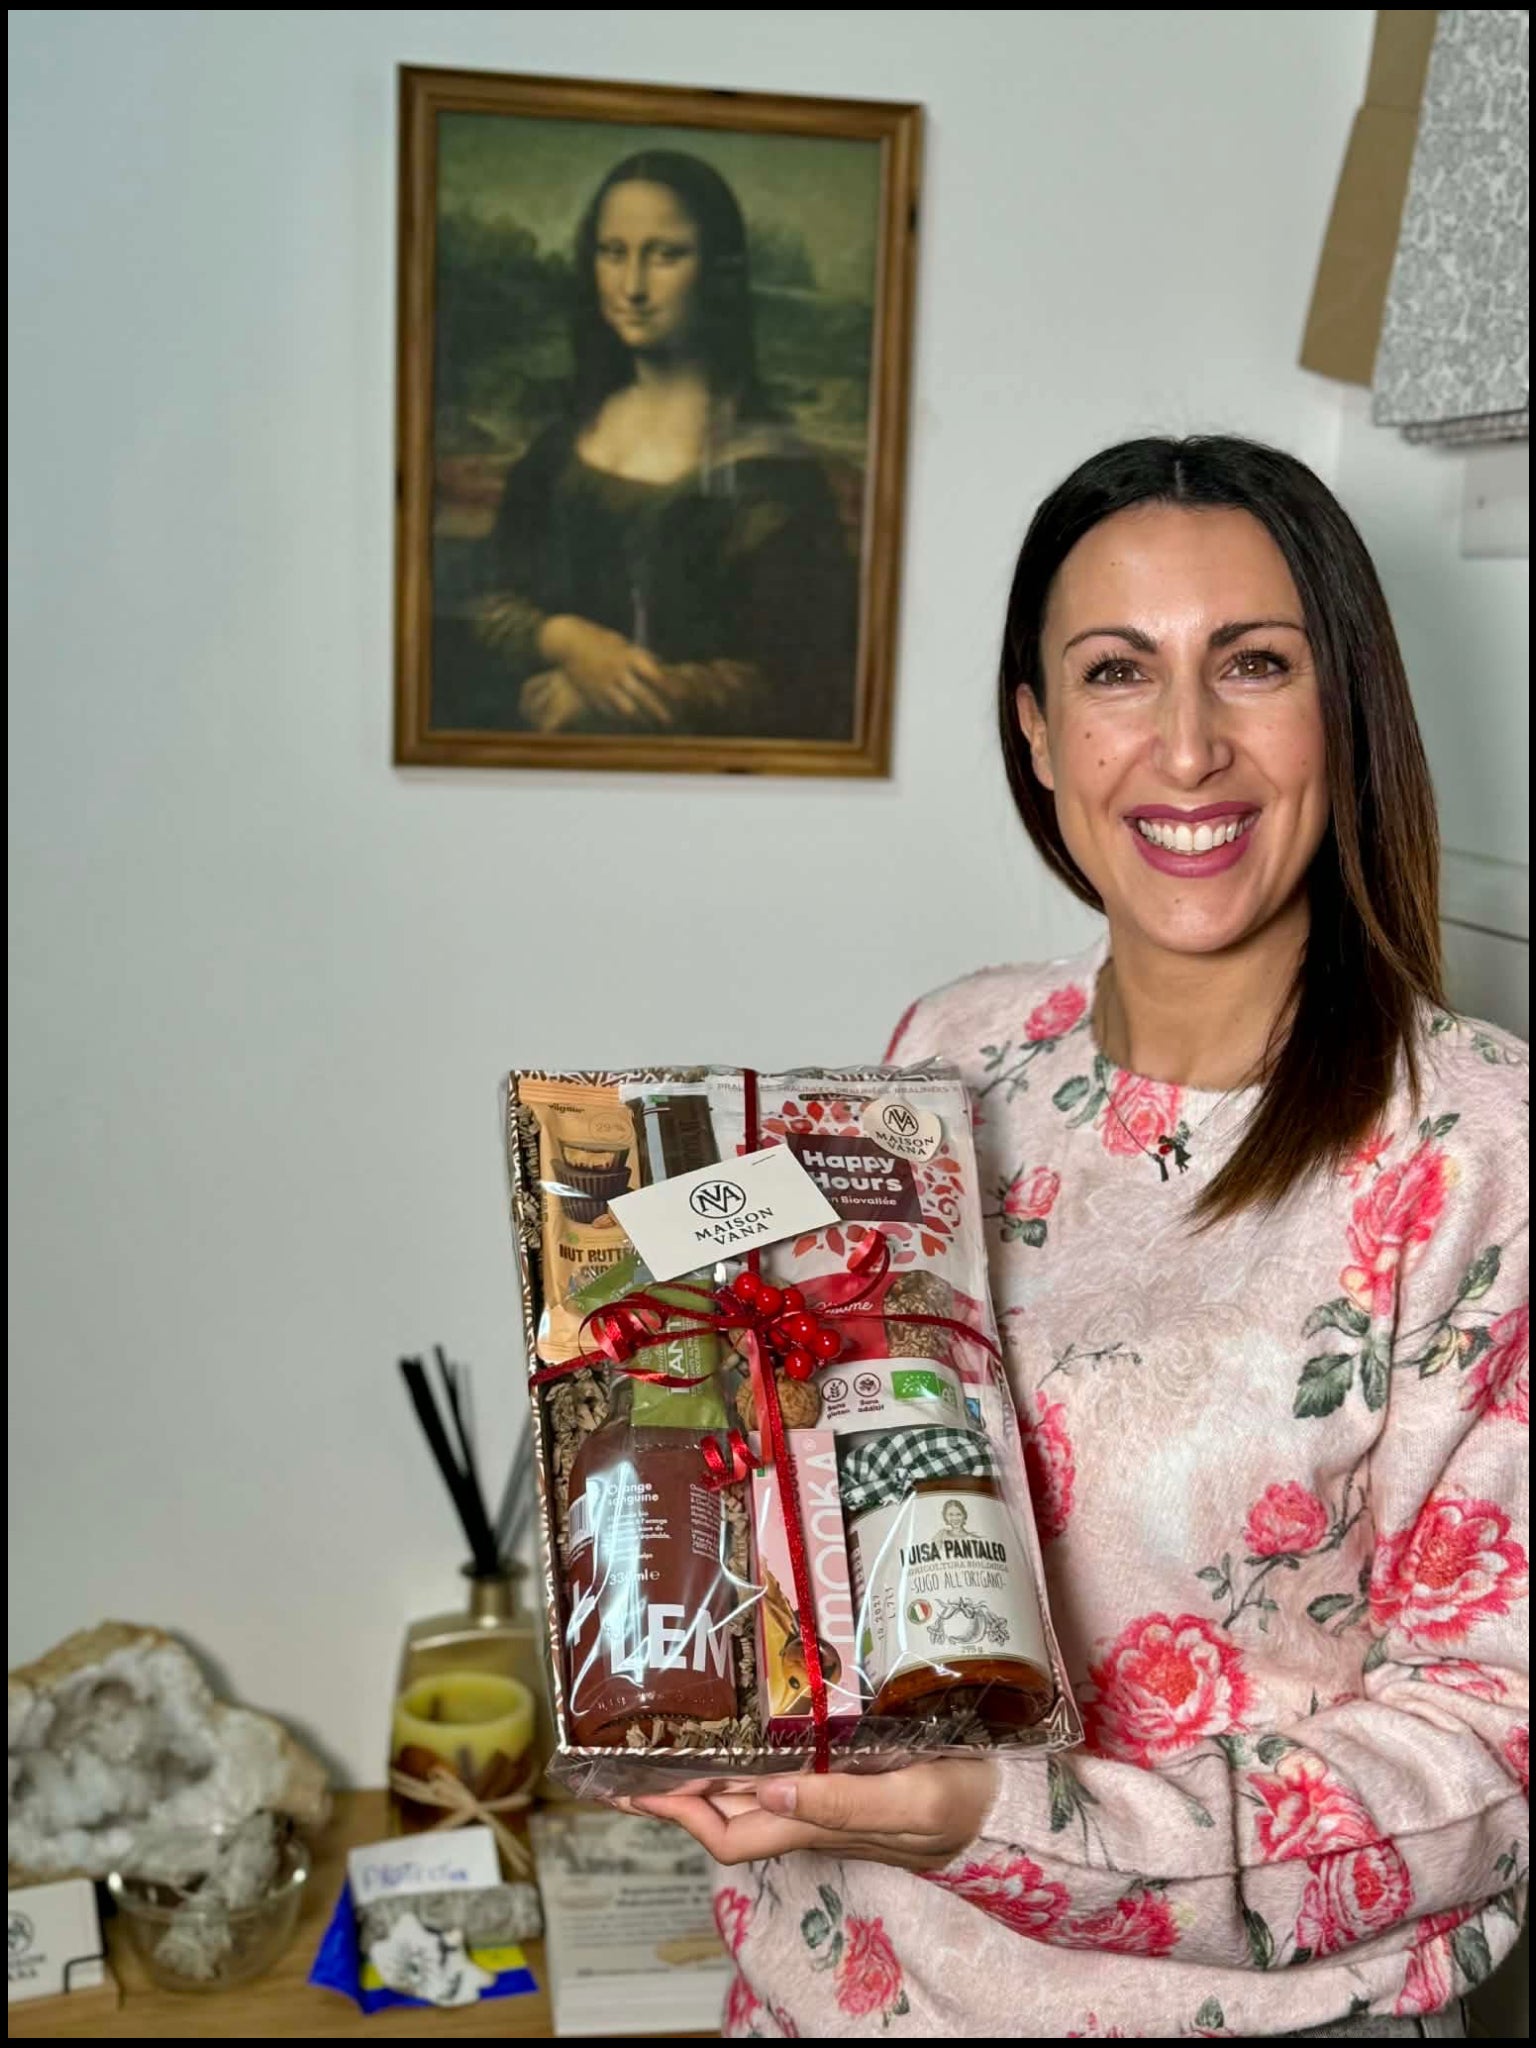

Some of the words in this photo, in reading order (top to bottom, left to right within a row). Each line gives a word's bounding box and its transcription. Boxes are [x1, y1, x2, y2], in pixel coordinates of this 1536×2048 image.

[875, 1131, 934, 1147] MAISON
[887, 1141, 927, 1155] VANA
[802, 1149, 896, 1174] Happy
[809, 1171, 903, 1192] Hours
[695, 1207, 774, 1241] MAISON
[713, 1222, 769, 1245] VANA
[559, 1243, 584, 1262] NUT
[609, 1482, 652, 1495] Oange
[944, 1539, 1006, 1563] PANTALEO
